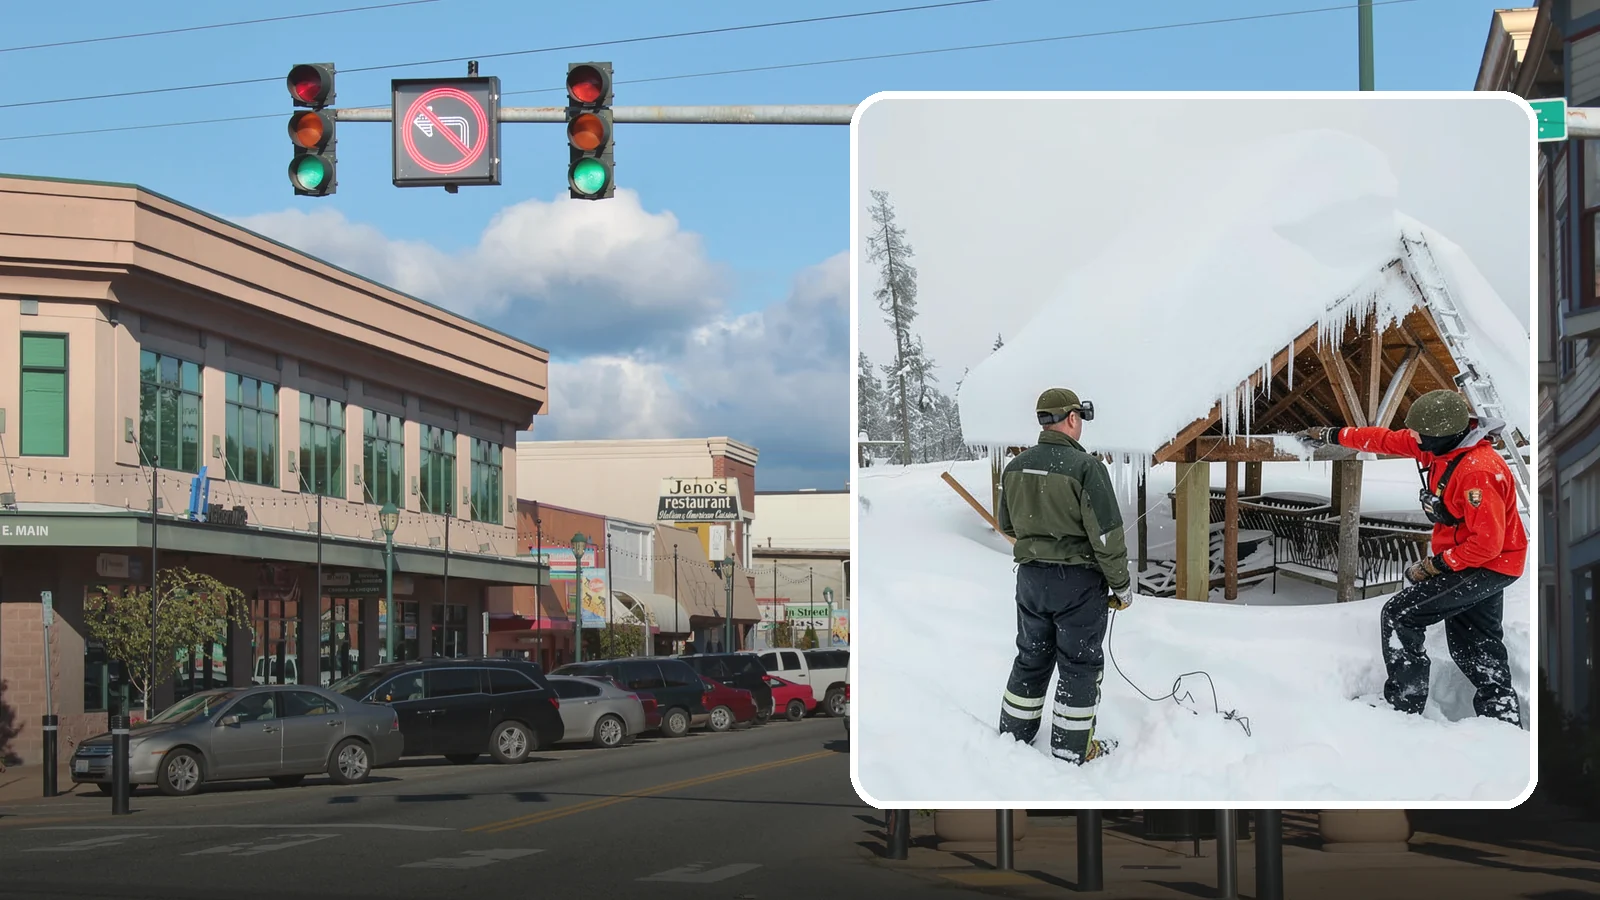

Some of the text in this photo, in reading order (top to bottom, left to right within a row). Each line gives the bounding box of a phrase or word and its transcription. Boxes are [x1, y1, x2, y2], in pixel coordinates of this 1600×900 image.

[669, 480, 728, 495] Jeno's
[665, 496, 731, 509] restaurant
[658, 509, 682, 519] Italian
[686, 509, 715, 519] American
[715, 509, 737, 519] Cuisine
[2, 525, 49, 536] E. MAIN
[797, 607, 829, 617] Street
